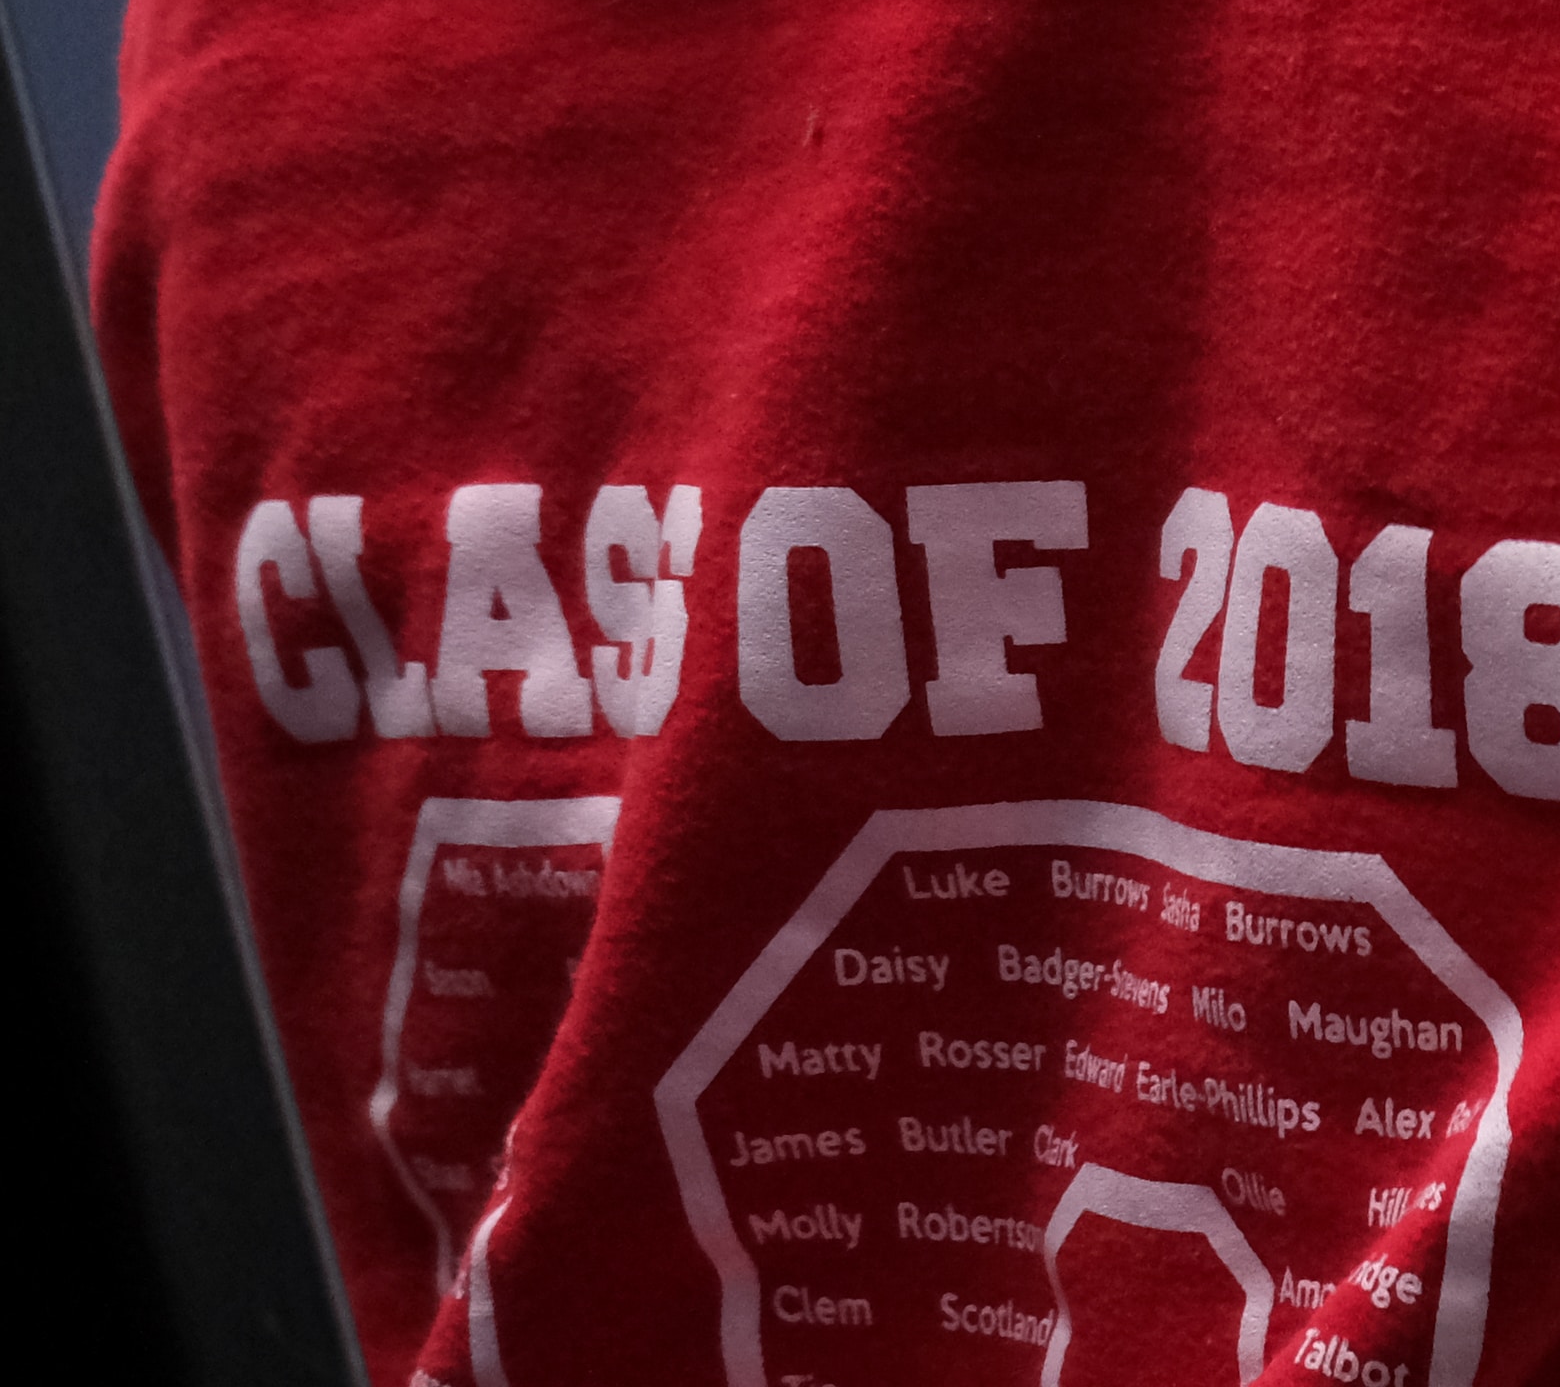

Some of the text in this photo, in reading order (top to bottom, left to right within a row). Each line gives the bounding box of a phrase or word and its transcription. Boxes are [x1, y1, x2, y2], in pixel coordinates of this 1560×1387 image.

[738, 480, 1089, 741] OF
[903, 859, 1371, 956] Luke Burrows Sasha Burrows
[834, 944, 1463, 1059] Daisy Badger-Stevens Milo Maughan
[758, 1041, 881, 1079] Matty
[918, 1031, 1046, 1071] Rosser
[1064, 1040, 1128, 1093] Edward
[1137, 1061, 1321, 1138] Earle-Phillips
[1355, 1097, 1436, 1139] Alex
[730, 1128, 866, 1166] James
[899, 1116, 1012, 1156] Butler
[1033, 1124, 1079, 1169] Clark
[1221, 1167, 1286, 1216] Ollie
[749, 1203, 862, 1250] Molly
[773, 1285, 1411, 1387] Clem Scotland Talbot
